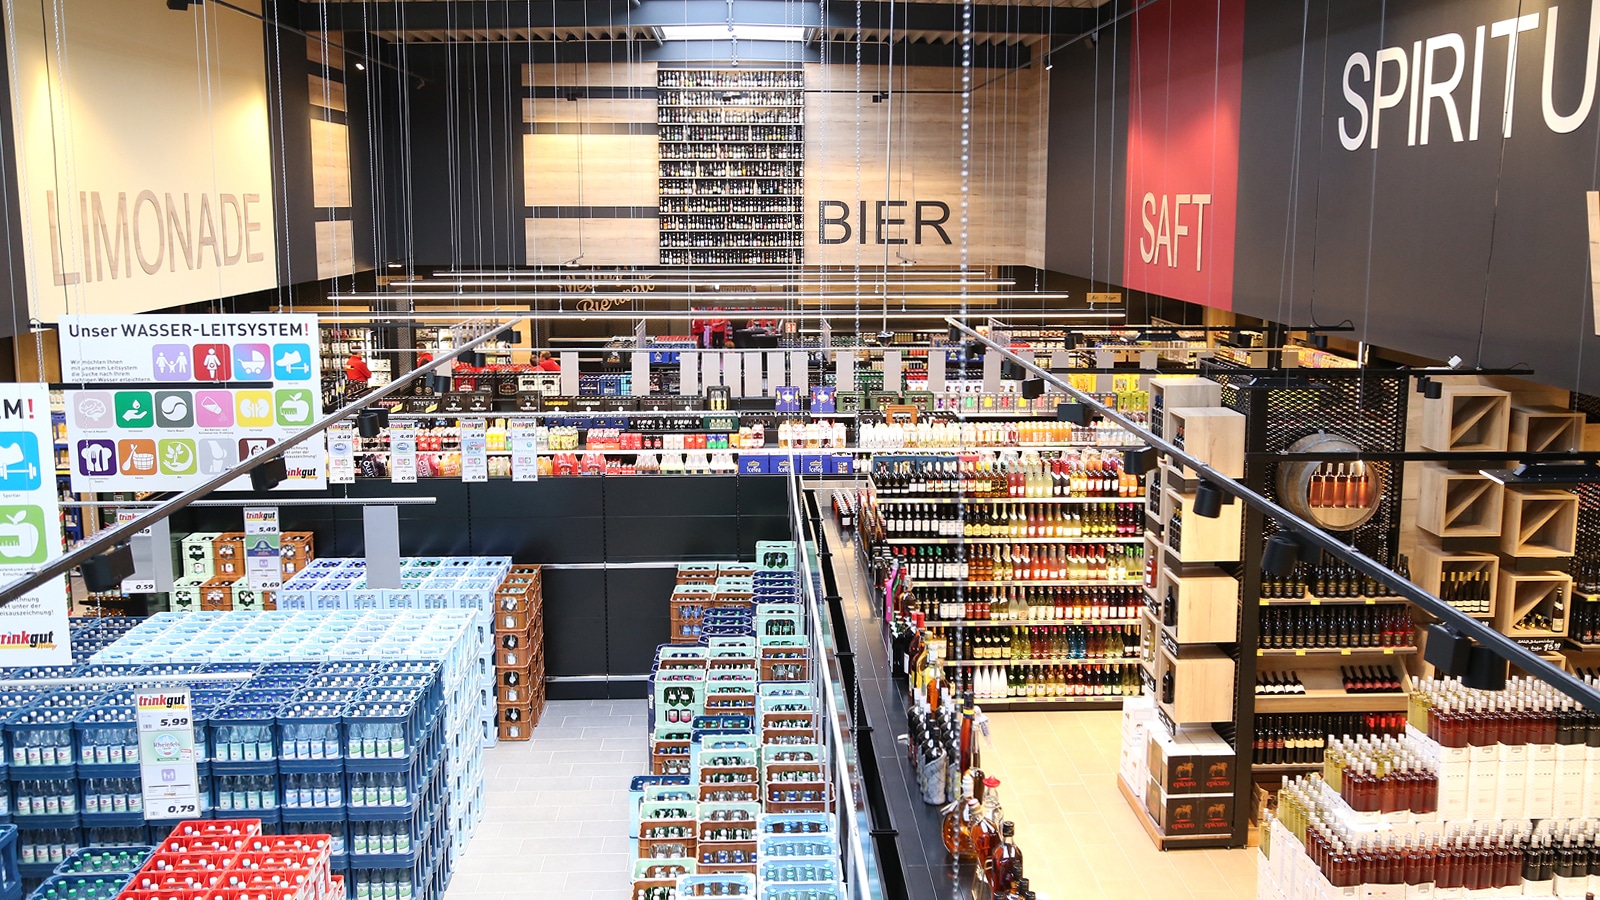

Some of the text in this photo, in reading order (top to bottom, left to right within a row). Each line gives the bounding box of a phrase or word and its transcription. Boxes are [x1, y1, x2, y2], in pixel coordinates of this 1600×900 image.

[1338, 0, 1600, 151] SPIRITU
[819, 201, 953, 244] BIER
[46, 189, 264, 286] LIMONADE
[1140, 192, 1212, 272] SAFT
[69, 323, 309, 337] Unser WASSER-LEITSYSTEM!
[0, 398, 34, 419] M!
[286, 467, 316, 478] inkgut
[246, 512, 276, 521] trinkgut
[0, 630, 54, 648] rinkgut
[139, 695, 186, 708] trinkgut
[160, 718, 188, 727] 5,99
[168, 804, 195, 814] 0,79
